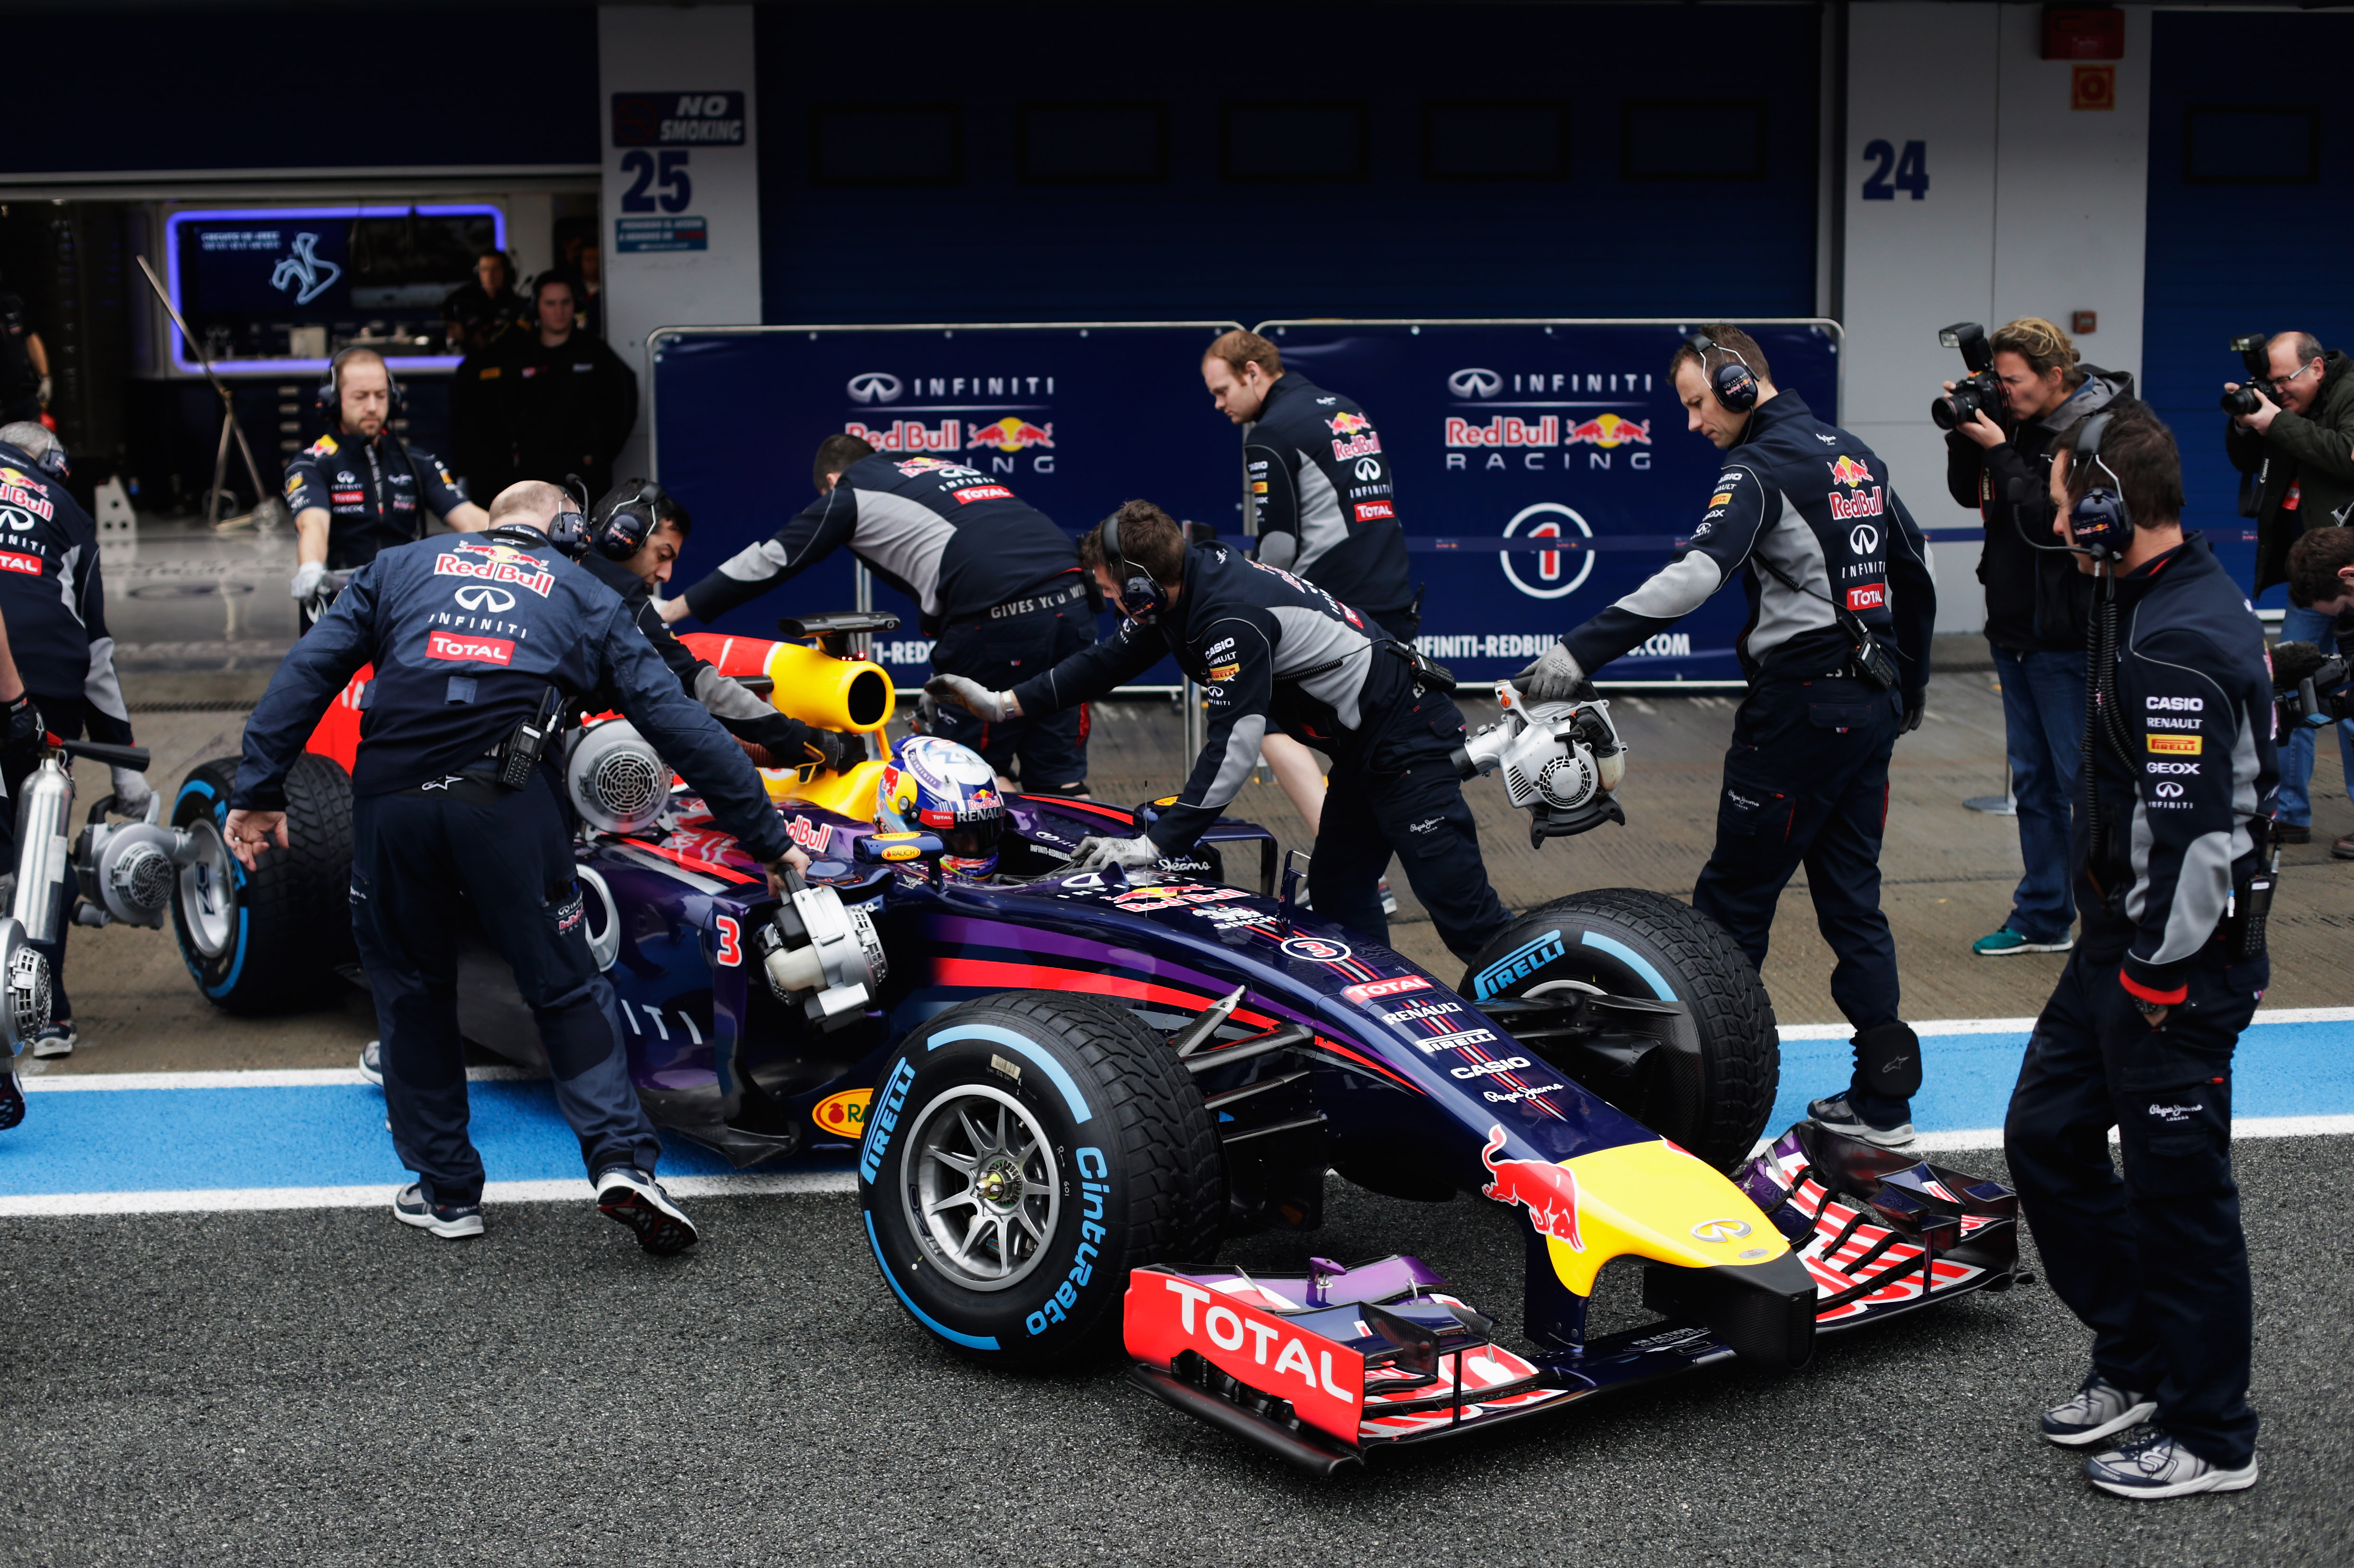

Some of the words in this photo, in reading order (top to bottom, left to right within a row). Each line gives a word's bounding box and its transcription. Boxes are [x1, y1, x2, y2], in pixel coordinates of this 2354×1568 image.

[676, 96, 728, 118] NO
[660, 119, 742, 141] SMOKING
[1862, 139, 1929, 200] 24
[620, 149, 692, 213] 25
[914, 377, 1055, 396] INFINITI
[1514, 374, 1652, 392] INFINITI
[1447, 453, 1651, 470] RACING
[1717, 472, 1743, 485] ASIO
[2259, 458, 2270, 484] Canon
[334, 492, 363, 501] TOTAL
[957, 488, 1010, 501] TOTAL
[1350, 484, 1391, 498] INFINITI
[333, 504, 365, 513] GEOX
[1357, 505, 1393, 518] TOTAL
[1528, 522, 1560, 580] 1
[0, 555, 38, 572] TAL
[1842, 561, 1885, 579] INFINITI
[1850, 590, 1883, 607] TOTAL
[990, 598, 1035, 619] GIVES
[427, 612, 527, 639] INFINITI
[433, 637, 507, 660] TOTAL
[1205, 637, 1235, 660] CASIO
[2146, 697, 2203, 711] CASIO
[2146, 717, 2203, 730] RENAULT
[2151, 738, 2196, 751] PIRELLI
[914, 760, 937, 785] INFINITI
[2146, 762, 2201, 775] GEOX
[2147, 801, 2194, 809] INFINITI
[1410, 823, 1426, 832] Pepe
[1425, 816, 1445, 829] Jeans
[1158, 859, 1212, 872] Jeans
[1213, 915, 1278, 930] SINGH
[716, 915, 742, 967] 3
[1294, 941, 1338, 957] 3
[1474, 929, 1566, 1001] PIRELLI
[1348, 977, 1432, 998] TOTAL
[1381, 1002, 1463, 1025] RENAULT
[1415, 1028, 1497, 1053] PIRELLI
[1450, 1057, 1531, 1079] CASIO
[1483, 1090, 1520, 1103] Pepe
[1516, 1082, 1564, 1100] Jeans
[2149, 1103, 2173, 1117] Pepe
[2172, 1104, 2203, 1116] Jeans
[859, 1056, 916, 1185] PIRELLI
[1166, 1279, 1354, 1404] TOTAL
[1649, 1327, 1694, 1341] ACTION
[1655, 1334, 1684, 1344] ROAD
[1682, 1327, 1709, 1337] SAFE
[2100, 1470, 2120, 1482] GEOX
